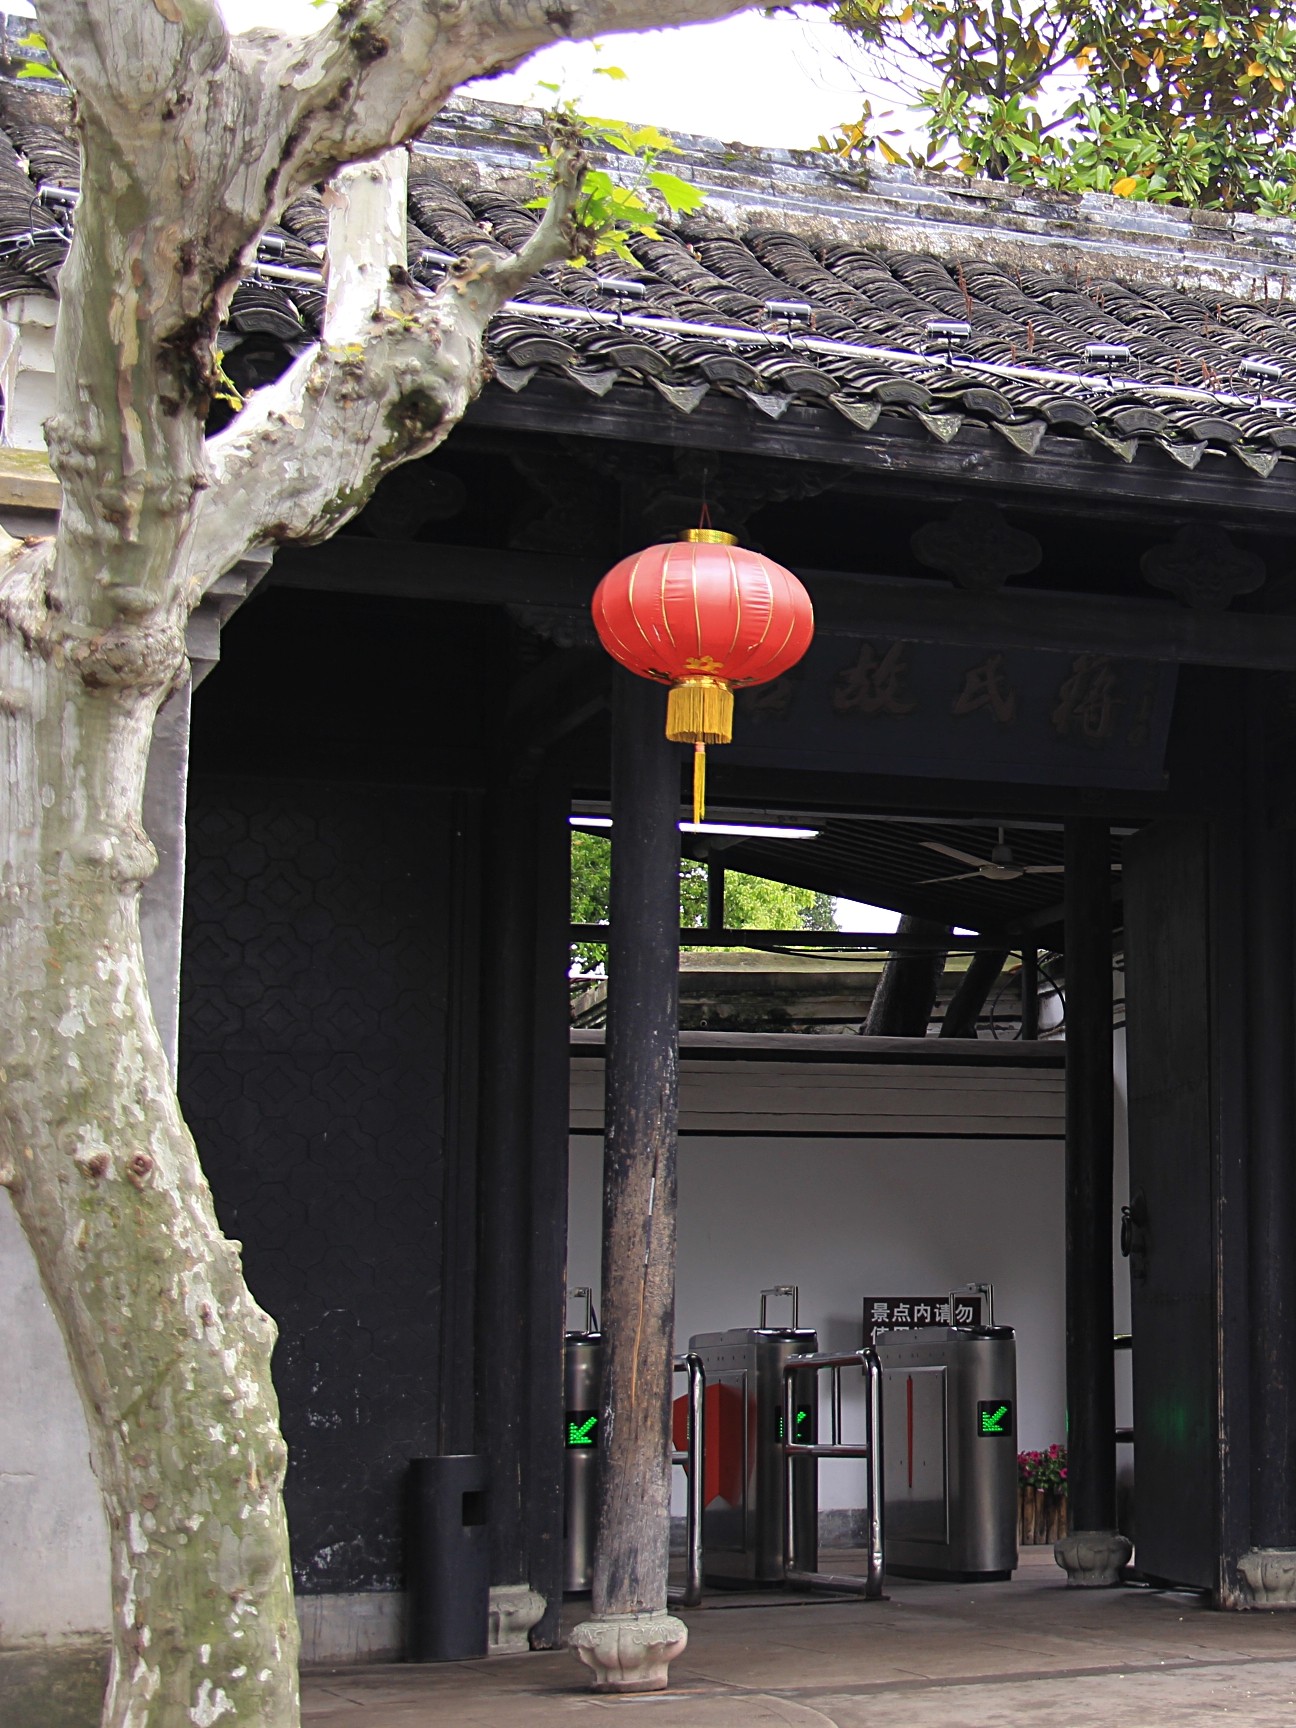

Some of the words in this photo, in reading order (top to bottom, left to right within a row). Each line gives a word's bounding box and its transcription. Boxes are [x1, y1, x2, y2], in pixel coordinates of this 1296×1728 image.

[871, 1302, 973, 1323] 景点内请勿
